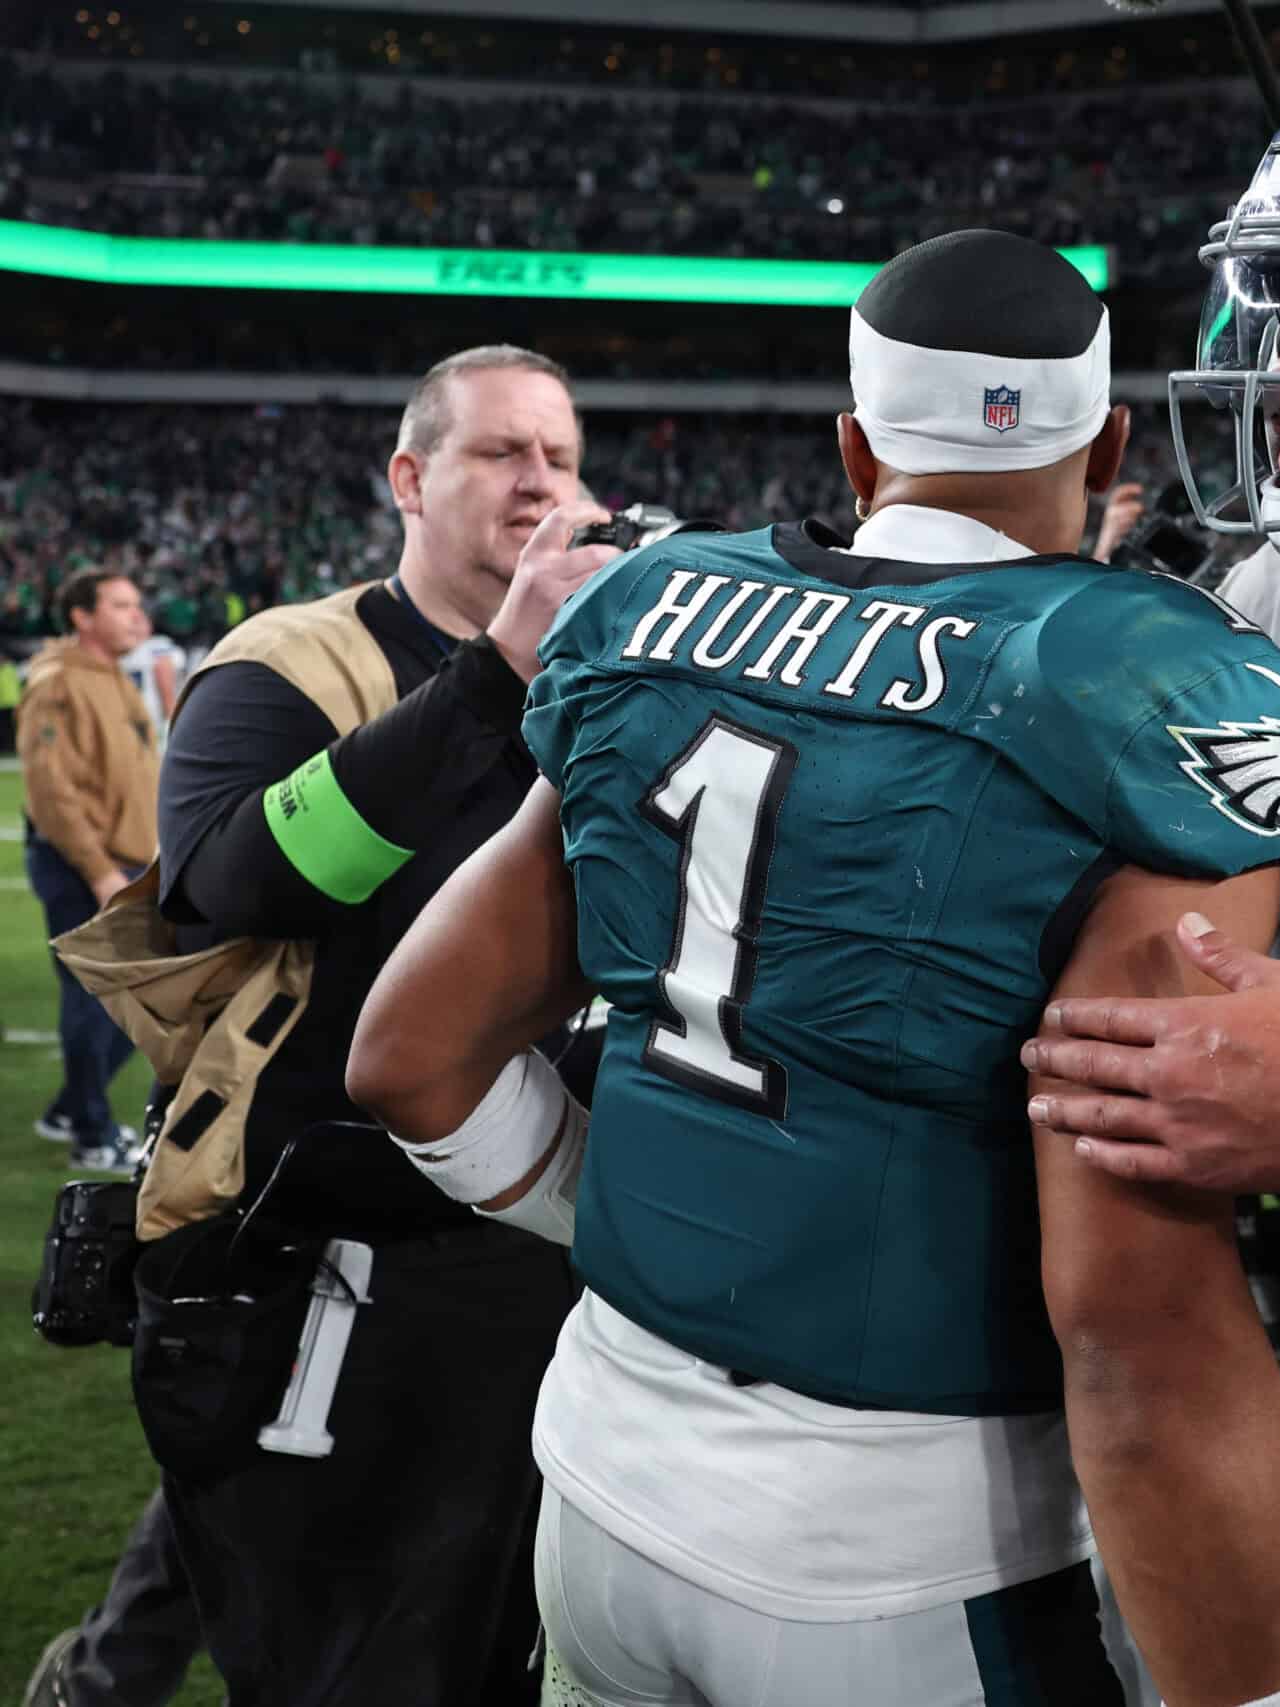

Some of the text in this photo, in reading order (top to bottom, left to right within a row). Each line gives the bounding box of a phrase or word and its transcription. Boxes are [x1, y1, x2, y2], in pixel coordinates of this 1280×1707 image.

[437, 257, 588, 285] EAGLES
[986, 404, 1016, 428] NFL
[621, 568, 981, 712] HURTS
[640, 714, 795, 1115] 1
